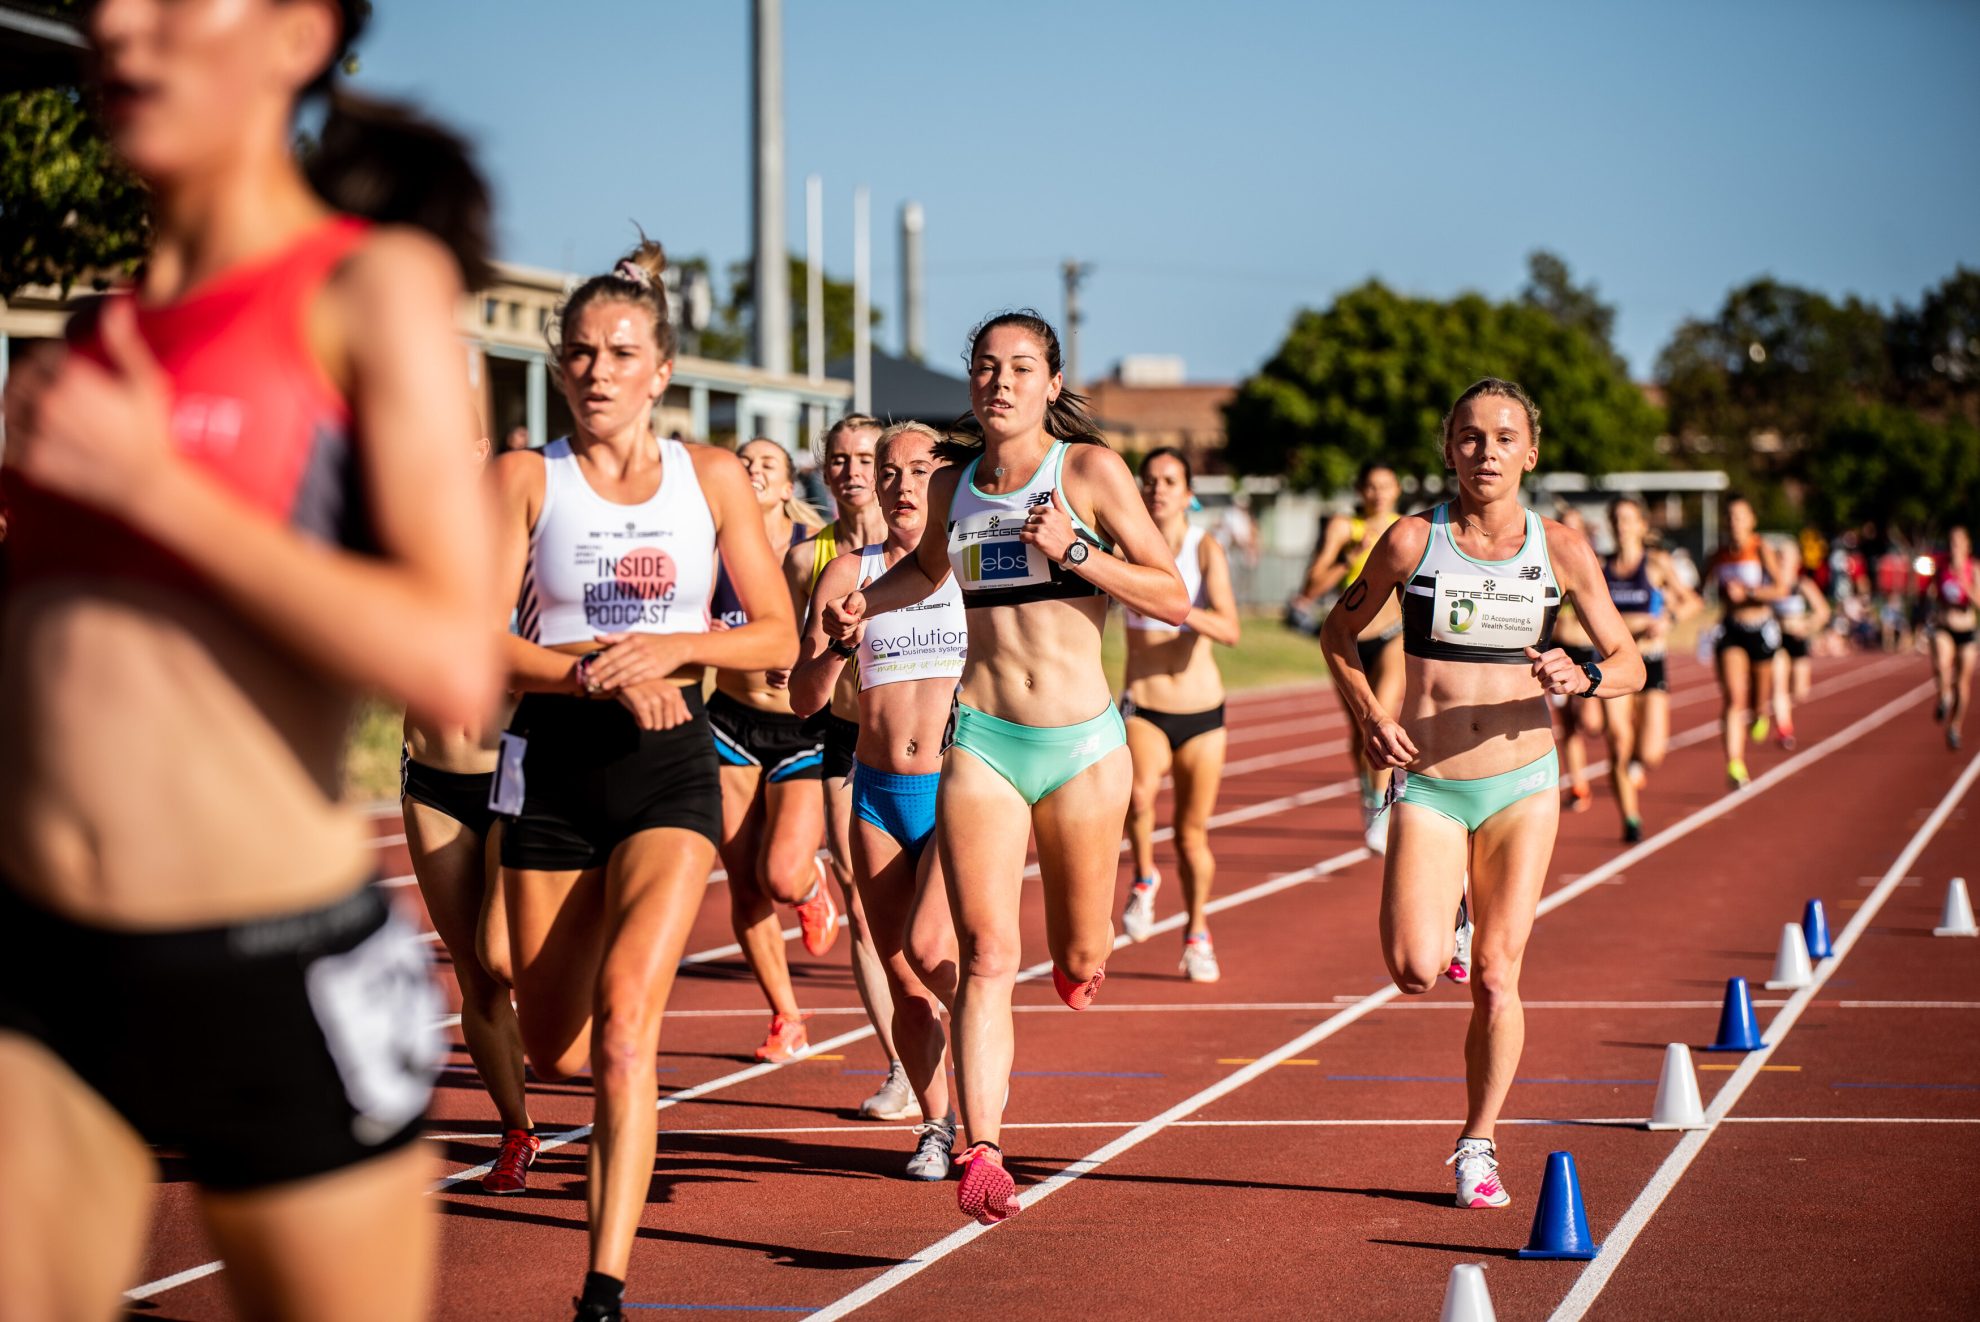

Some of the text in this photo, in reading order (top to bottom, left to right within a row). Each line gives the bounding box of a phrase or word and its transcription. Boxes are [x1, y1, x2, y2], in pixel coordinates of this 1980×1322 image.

[958, 528, 1022, 541] STEIGE
[981, 547, 1029, 571] ebs
[598, 556, 666, 577] INSIDE
[583, 581, 676, 603] RUNNING
[1445, 589, 1534, 604] STEIGEN
[585, 604, 671, 625] PODCAST
[1491, 615, 1526, 625] Accounting
[1481, 622, 1533, 632] Wealth Solutions
[902, 648, 936, 656] business
[877, 661, 917, 674] making
